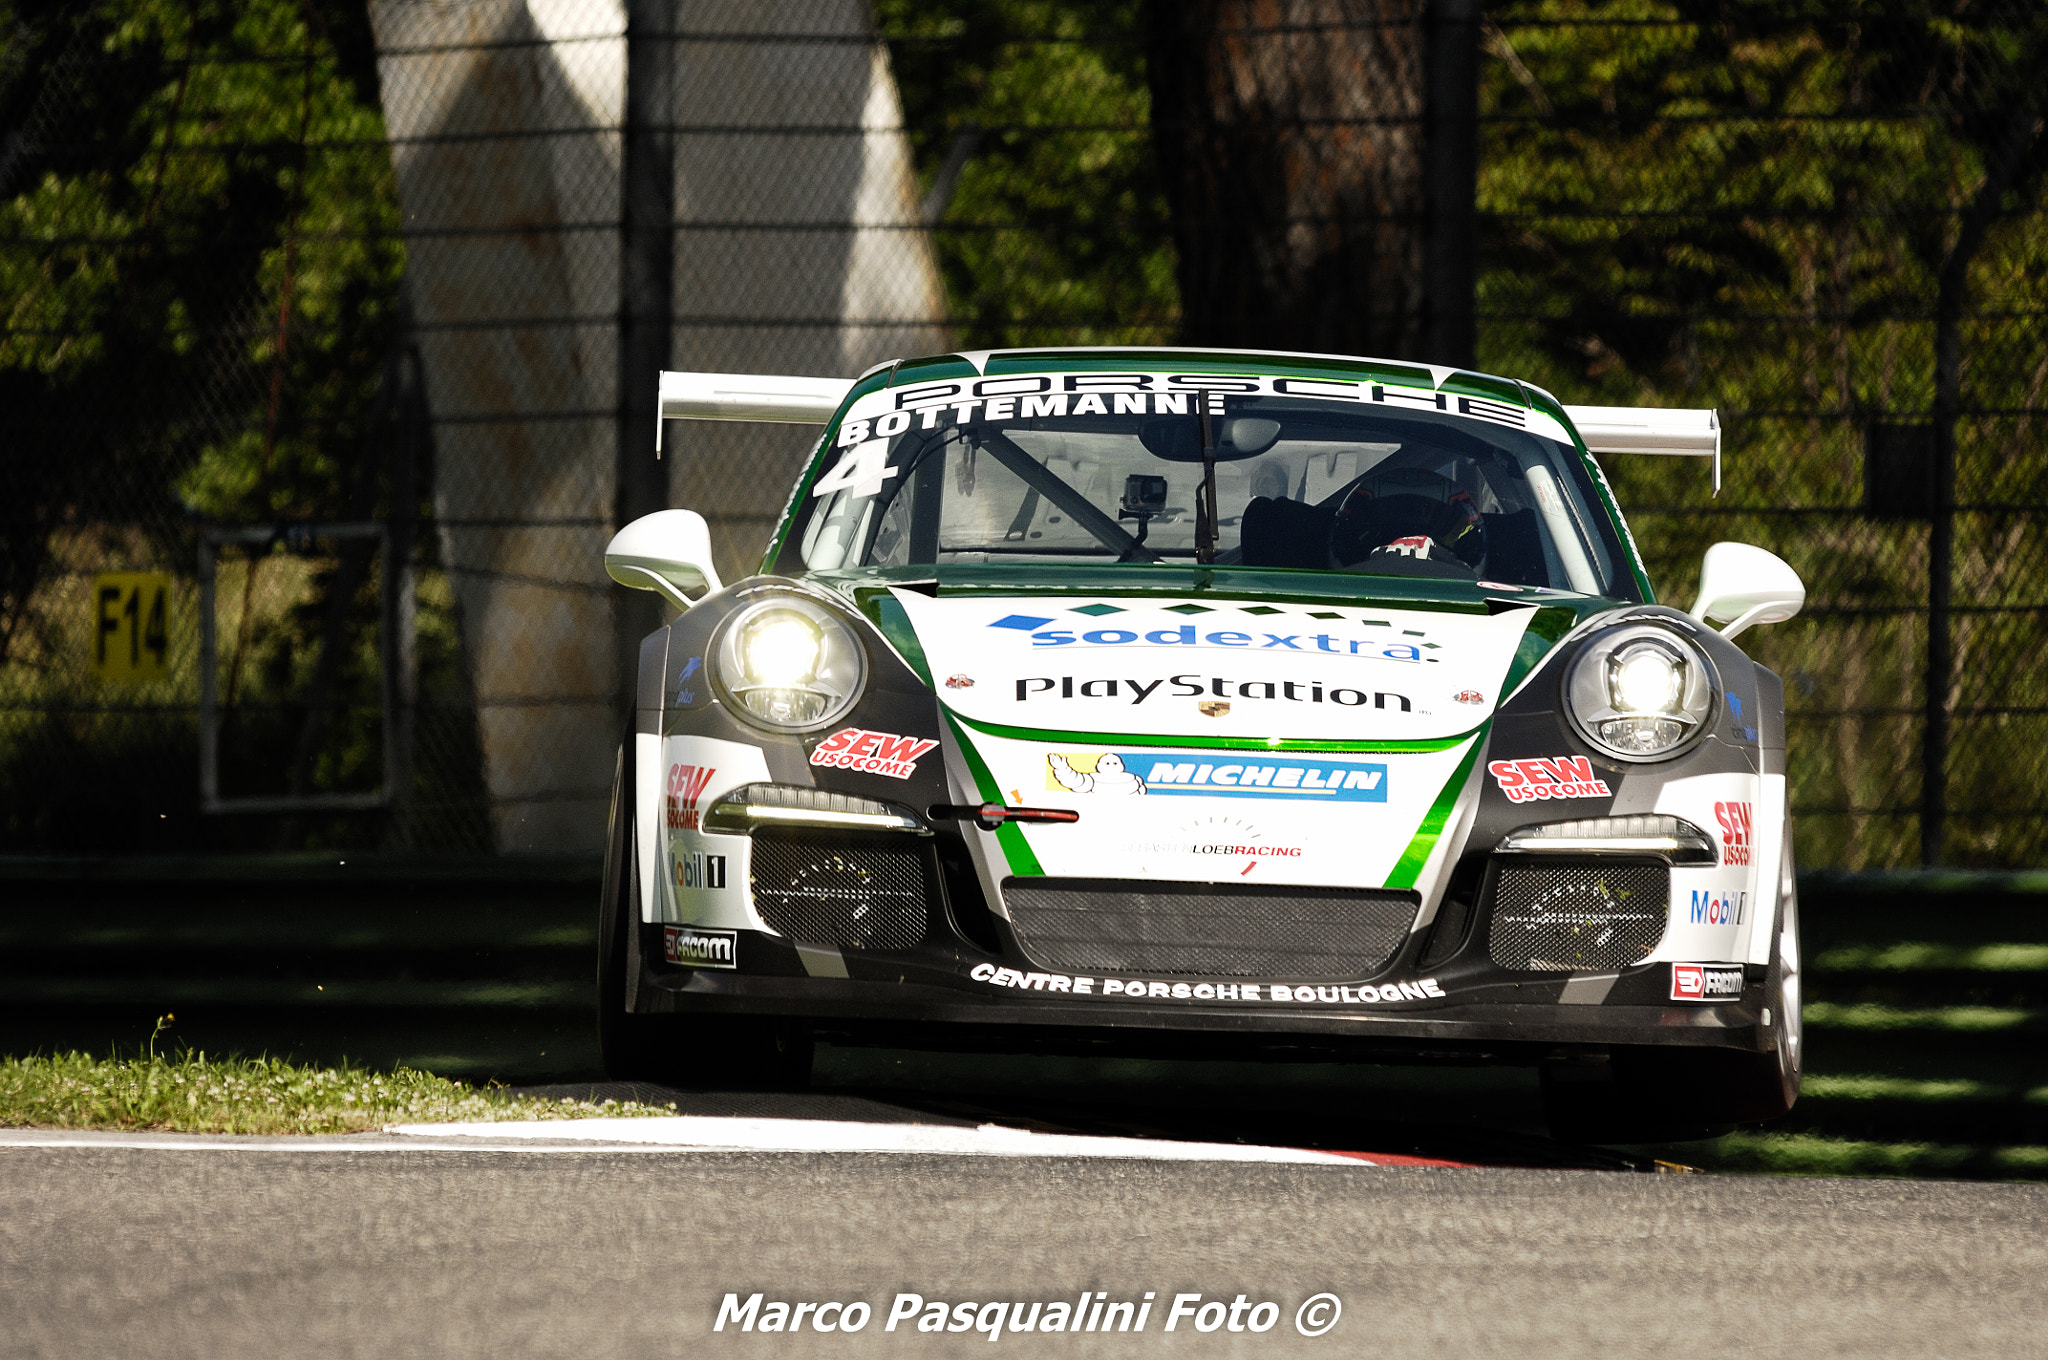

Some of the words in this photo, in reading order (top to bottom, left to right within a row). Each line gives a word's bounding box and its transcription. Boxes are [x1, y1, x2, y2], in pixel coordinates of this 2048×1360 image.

[896, 374, 1525, 428] PORSCHE
[837, 393, 1224, 448] BOTTEMANNE
[812, 434, 898, 498] 4
[97, 585, 168, 666] F14
[1032, 624, 1421, 662] sodextra
[1016, 674, 1411, 712] PlayStation
[812, 750, 912, 777] USOCOME
[820, 729, 935, 763] SEW
[667, 763, 717, 810] SEW
[1146, 761, 1382, 791] MICHELIN
[1492, 757, 1595, 787] SEW
[1507, 781, 1609, 801] USOCOME
[1690, 889, 1738, 925] Mobil
[970, 962, 1093, 995] CENTRE
[1103, 979, 1261, 1001] PORSCHE
[1270, 978, 1447, 1003] BOULOGNE
